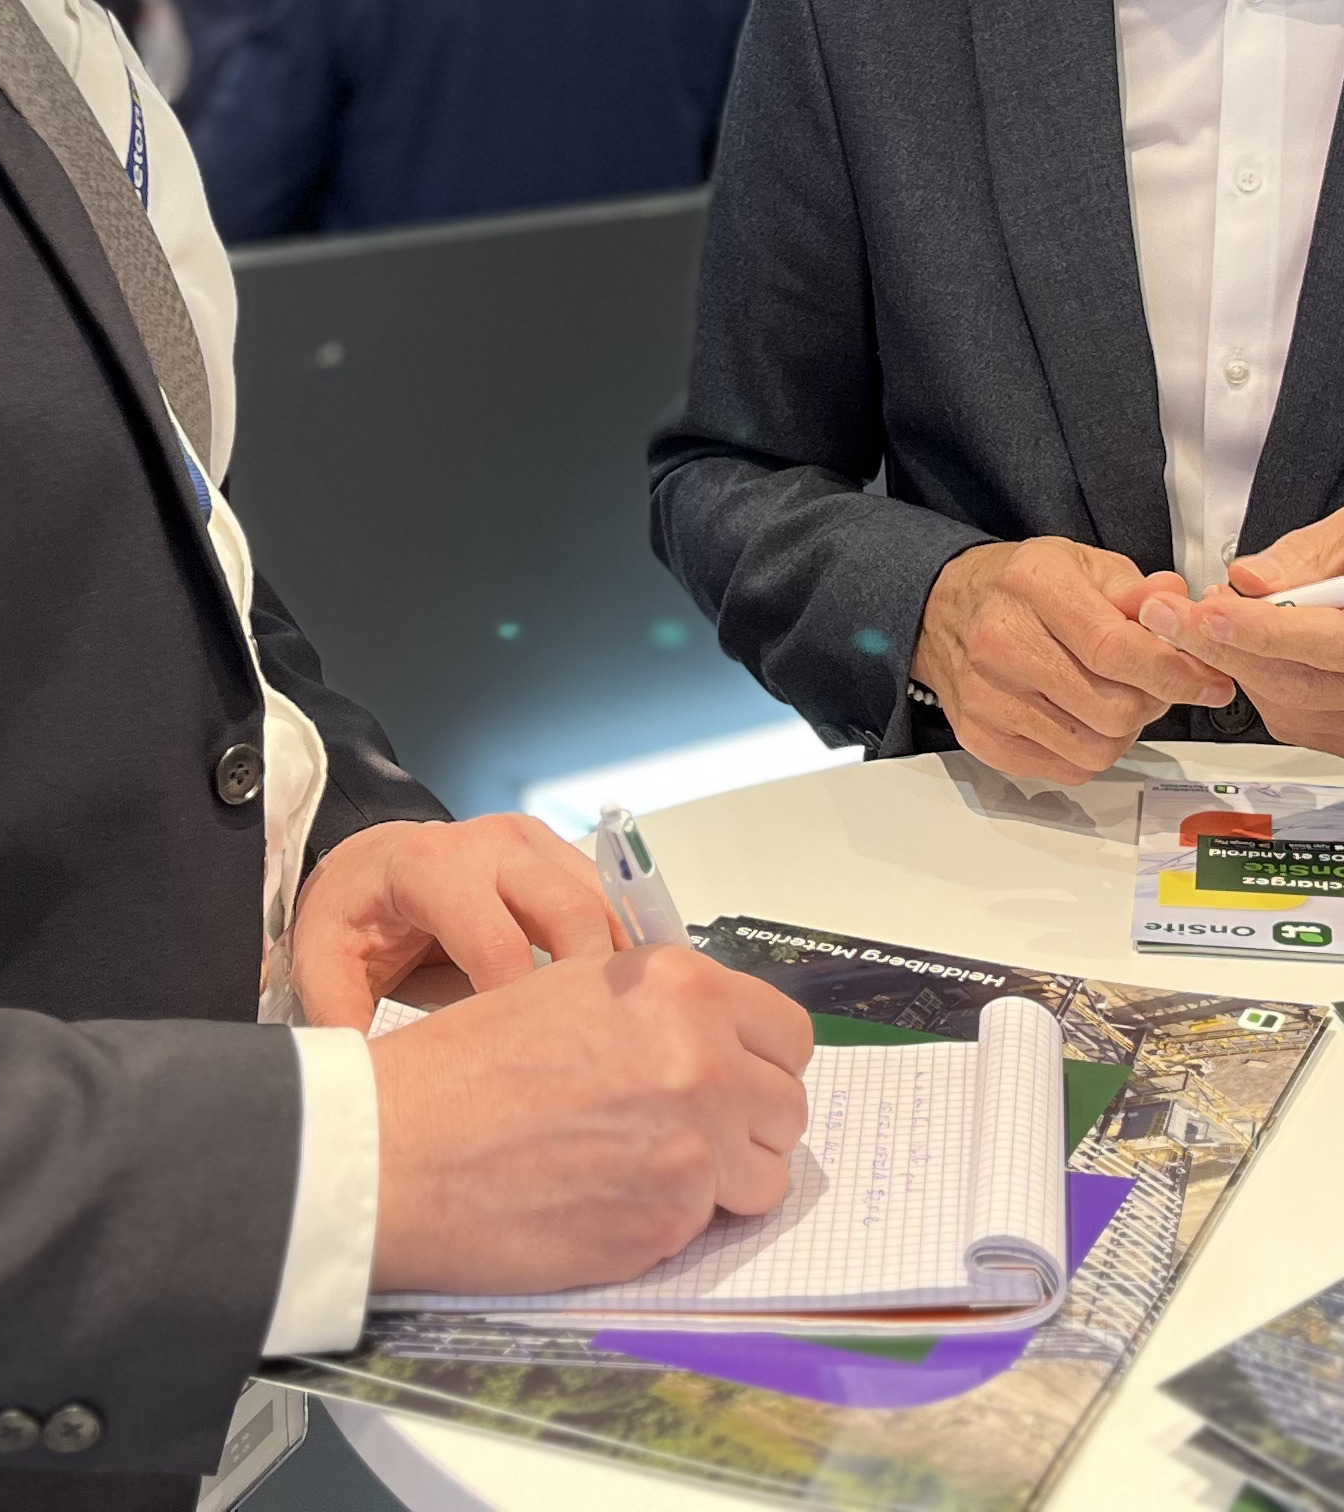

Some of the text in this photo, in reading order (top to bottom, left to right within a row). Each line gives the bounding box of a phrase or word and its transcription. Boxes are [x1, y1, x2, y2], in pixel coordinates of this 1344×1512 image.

[1208, 848, 1286, 860] Android
[1292, 852, 1312, 861] et
[1144, 921, 1256, 937] OnSite
[735, 926, 858, 959] Materials
[859, 949, 1006, 988] Heidelberg
